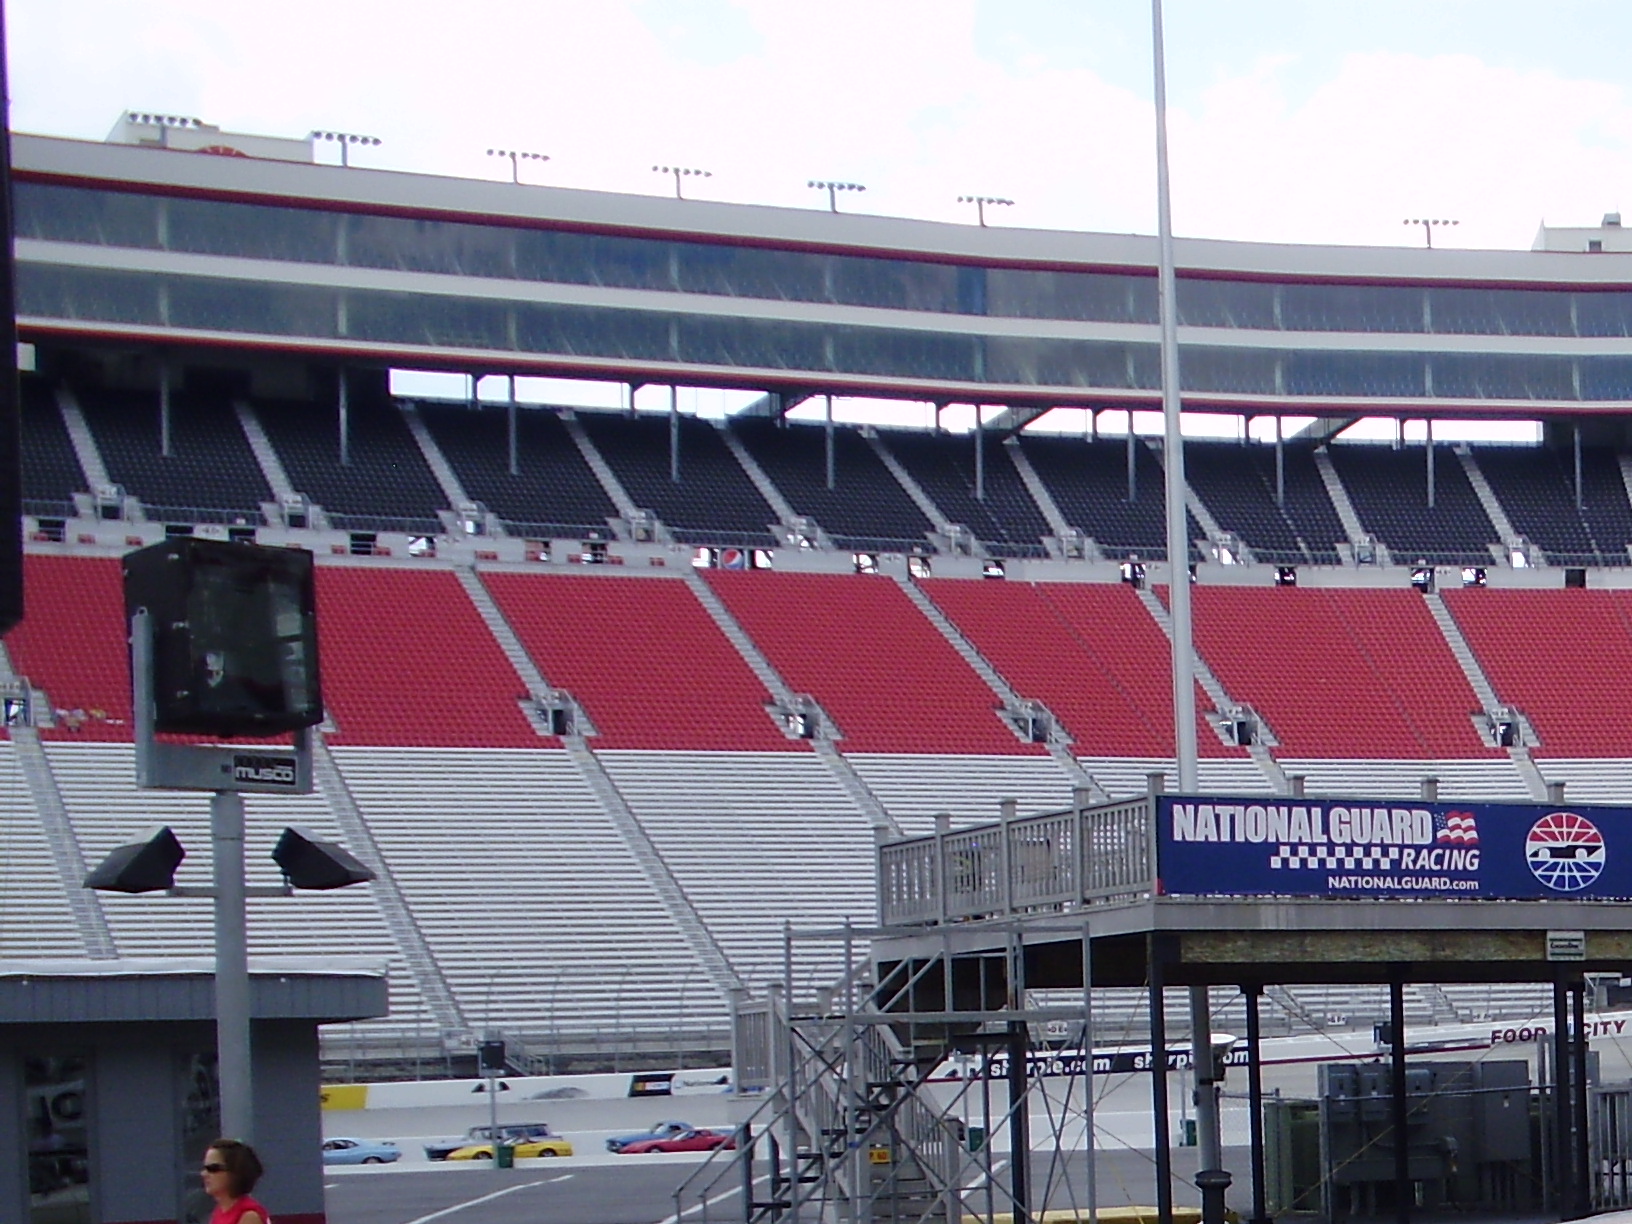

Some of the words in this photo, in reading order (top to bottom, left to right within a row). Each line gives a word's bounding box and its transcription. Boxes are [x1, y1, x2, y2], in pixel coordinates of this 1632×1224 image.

[1173, 804, 1328, 844] NATIONAL
[1329, 806, 1433, 845] GUARD
[1401, 848, 1480, 872] RACING
[1328, 875, 1479, 891] NATIONALGUARD.com
